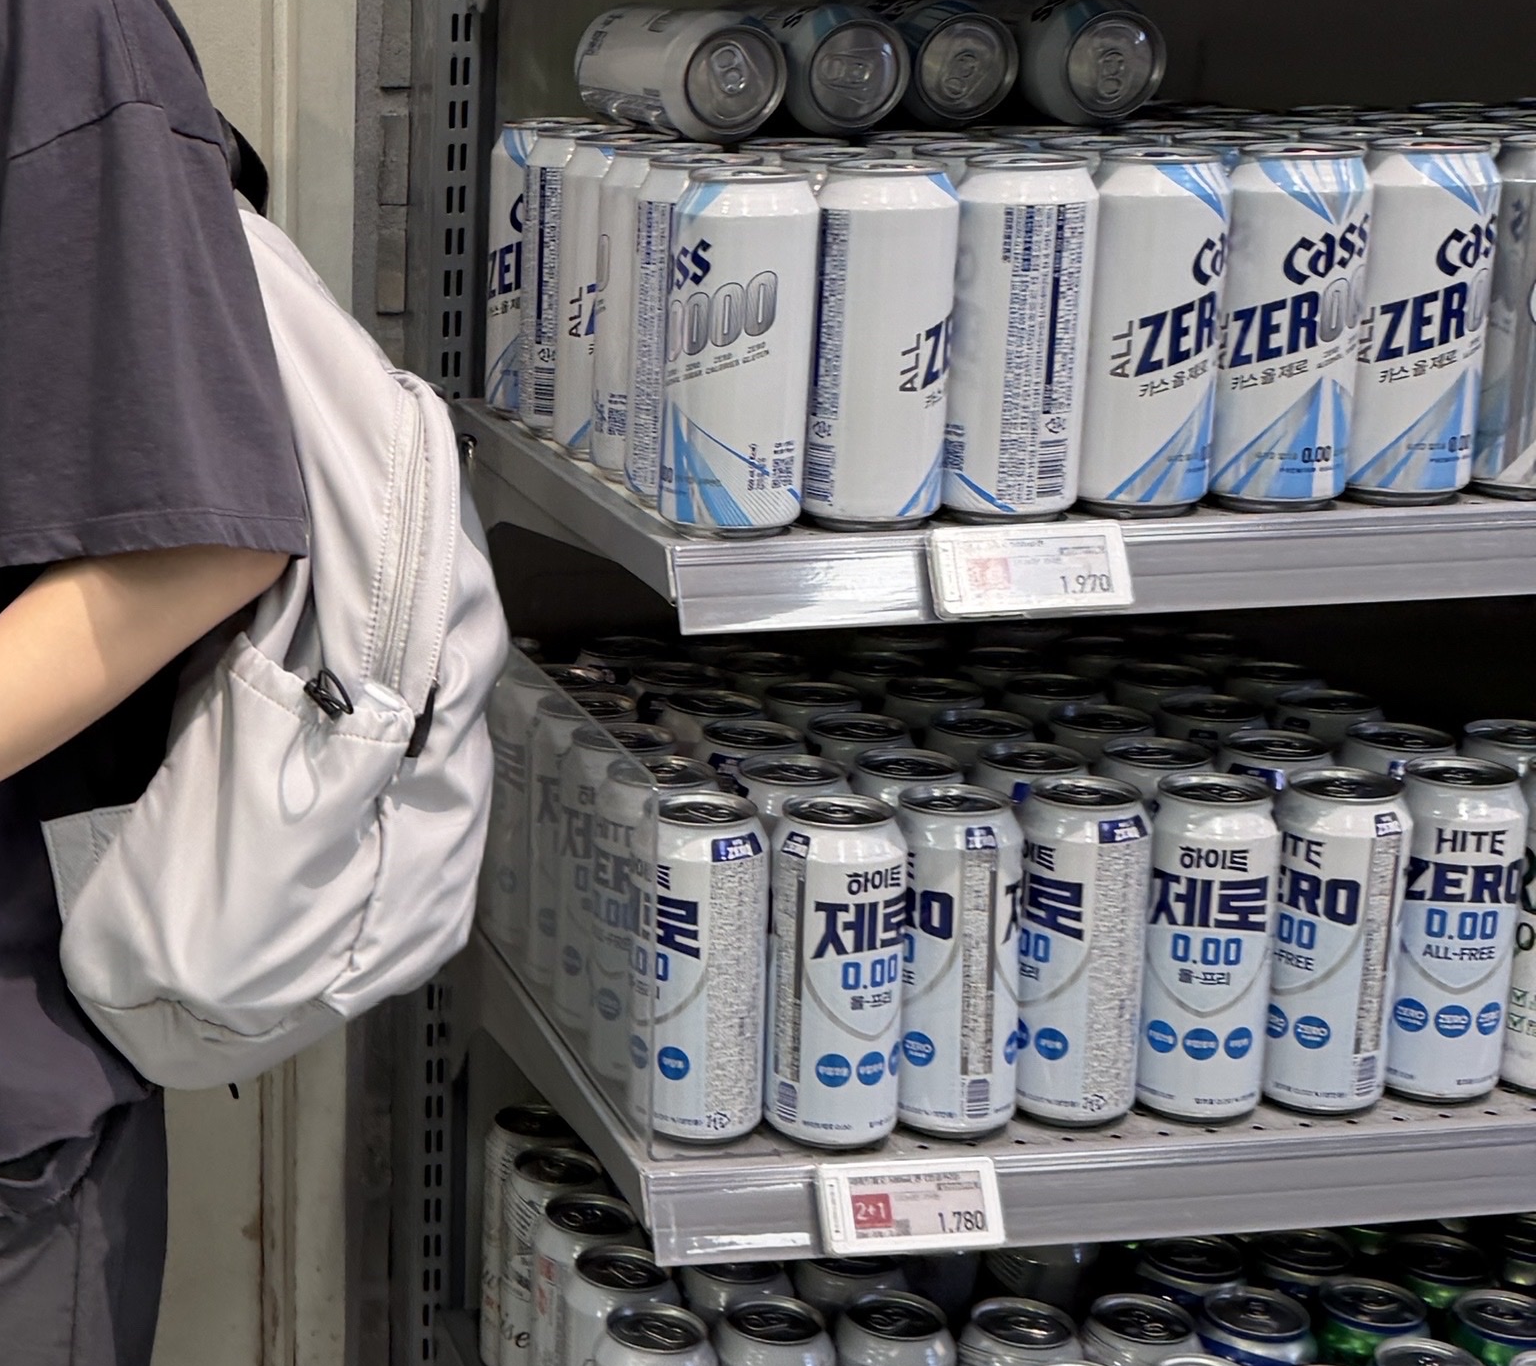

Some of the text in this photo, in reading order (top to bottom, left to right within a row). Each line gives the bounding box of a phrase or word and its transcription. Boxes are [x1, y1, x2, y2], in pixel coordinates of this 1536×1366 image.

[899, 333, 921, 391] ALL
[1109, 320, 1134, 378] ALL
[1138, 378, 1170, 397] 카스
[1172, 370, 1186, 389] 올
[1231, 372, 1259, 391] 카스
[1261, 367, 1276, 386] 올
[1278, 358, 1309, 379] 제로
[1378, 366, 1410, 384] 카스
[1412, 359, 1429, 378] 올
[1436, 827, 1509, 857] HITE
[1179, 846, 1250, 873] 하이트
[846, 863, 903, 897] 하이트
[1405, 857, 1524, 904] ZERO
[1149, 867, 1270, 933] 제로
[1426, 907, 1499, 941] 0.00
[1172, 933, 1243, 966] 0.00
[1422, 943, 1496, 962] ALL-FREE
[841, 954, 898, 990] 0.00
[855, 1202, 886, 1221] 2+1
